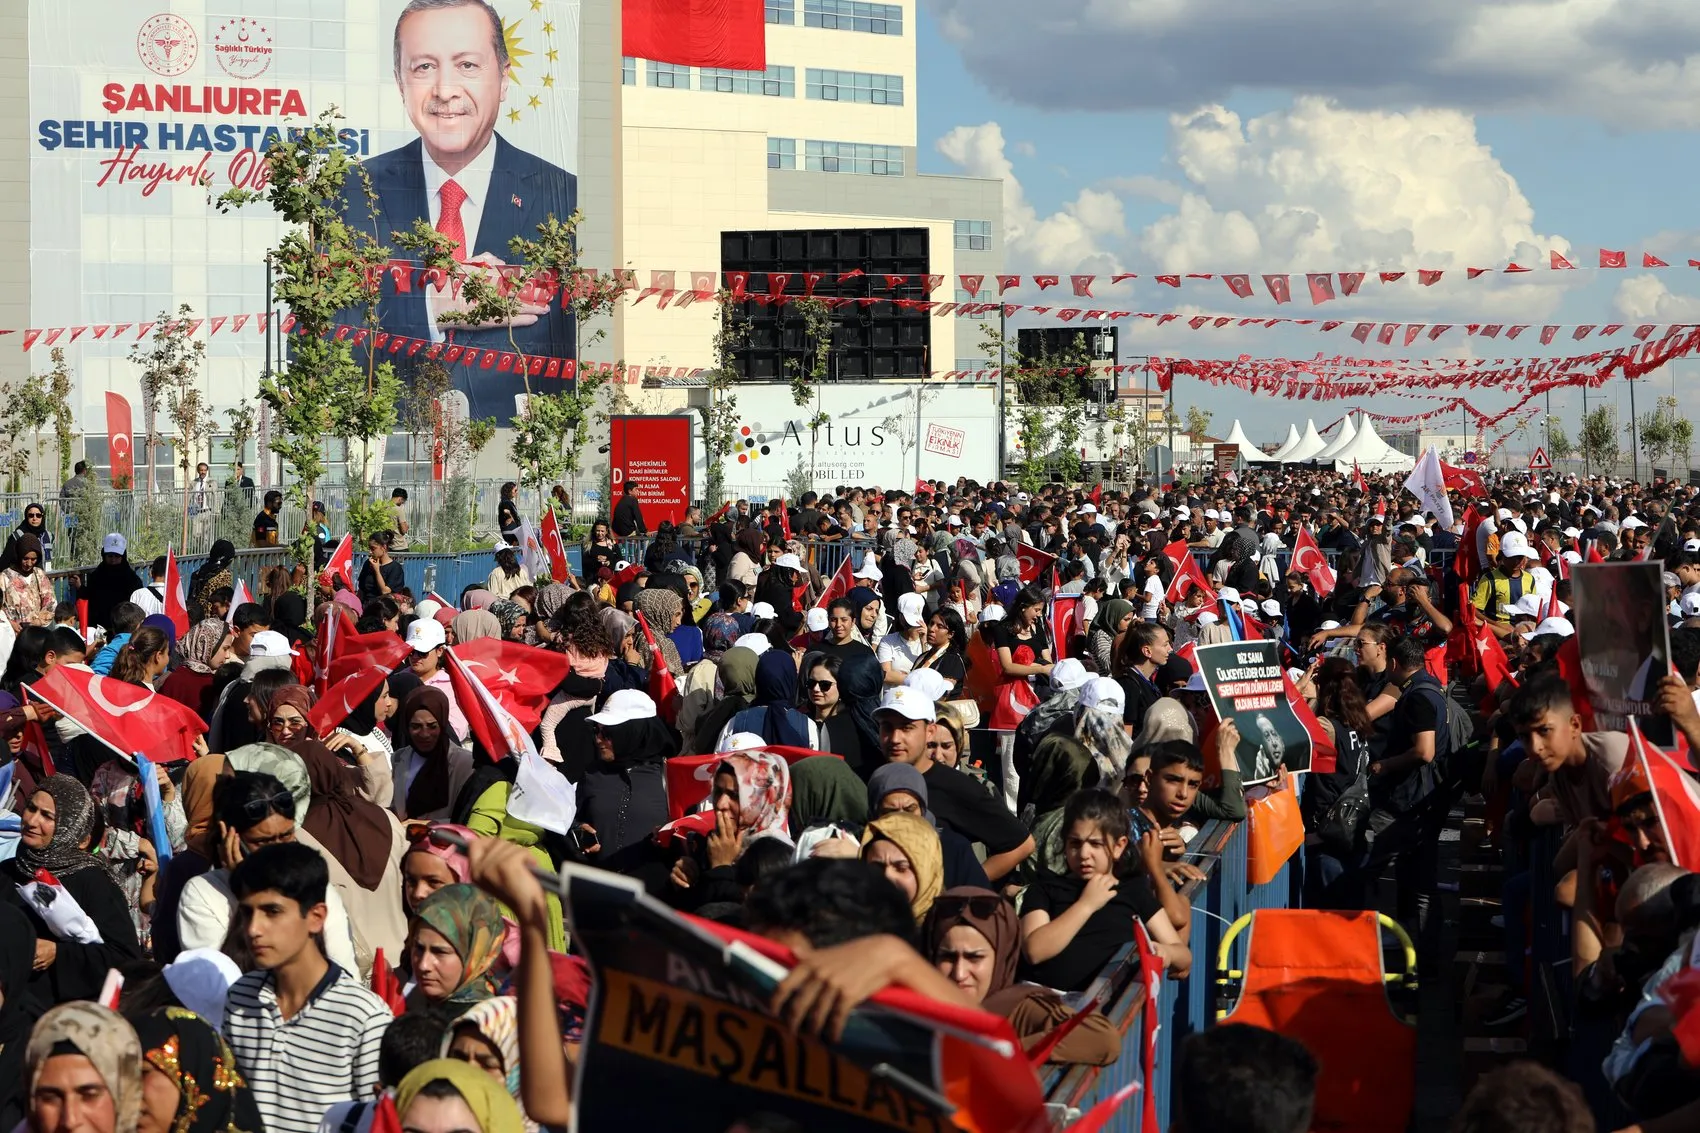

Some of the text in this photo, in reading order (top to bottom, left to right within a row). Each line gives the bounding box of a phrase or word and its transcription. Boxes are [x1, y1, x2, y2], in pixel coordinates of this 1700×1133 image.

[215, 44, 273, 54] Sağlıklı Türkiye
[102, 83, 307, 116] ŞANLIURFA
[38, 119, 149, 151] ŞEHİR
[97, 144, 215, 197] Hayırlı
[613, 467, 623, 485] D
[841, 469, 865, 480] LED
[1237, 651, 1264, 664] BİZ SANA
[1258, 667, 1266, 678] OL
